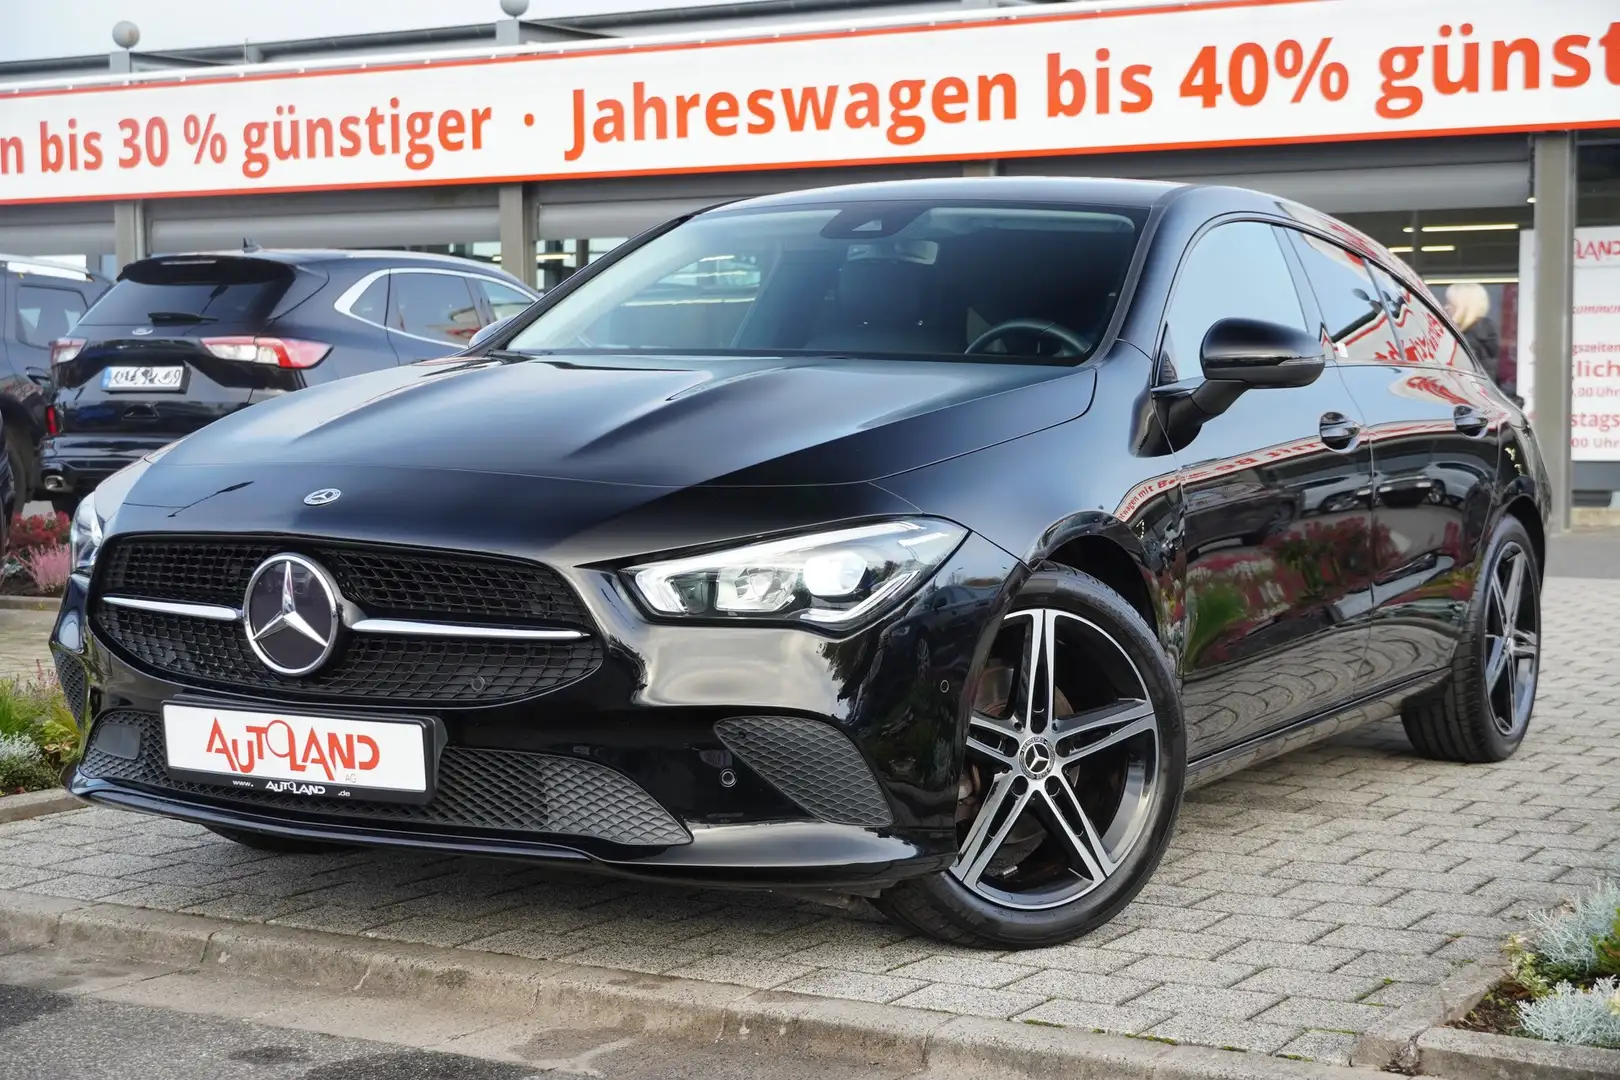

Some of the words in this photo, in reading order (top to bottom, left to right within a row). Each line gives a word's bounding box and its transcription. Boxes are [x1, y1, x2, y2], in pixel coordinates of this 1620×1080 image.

[0, 136, 24, 175] n
[40, 118, 102, 173] bis
[119, 116, 169, 169] 30
[184, 113, 228, 165] %
[242, 97, 492, 178] günstiger
[564, 73, 1017, 161] Jahreswagen
[1047, 47, 1154, 118] bis
[1179, 37, 1350, 109] 40%
[1375, 22, 1620, 119] günst
[1573, 239, 1620, 261] LAND
[1572, 360, 1620, 380] lich
